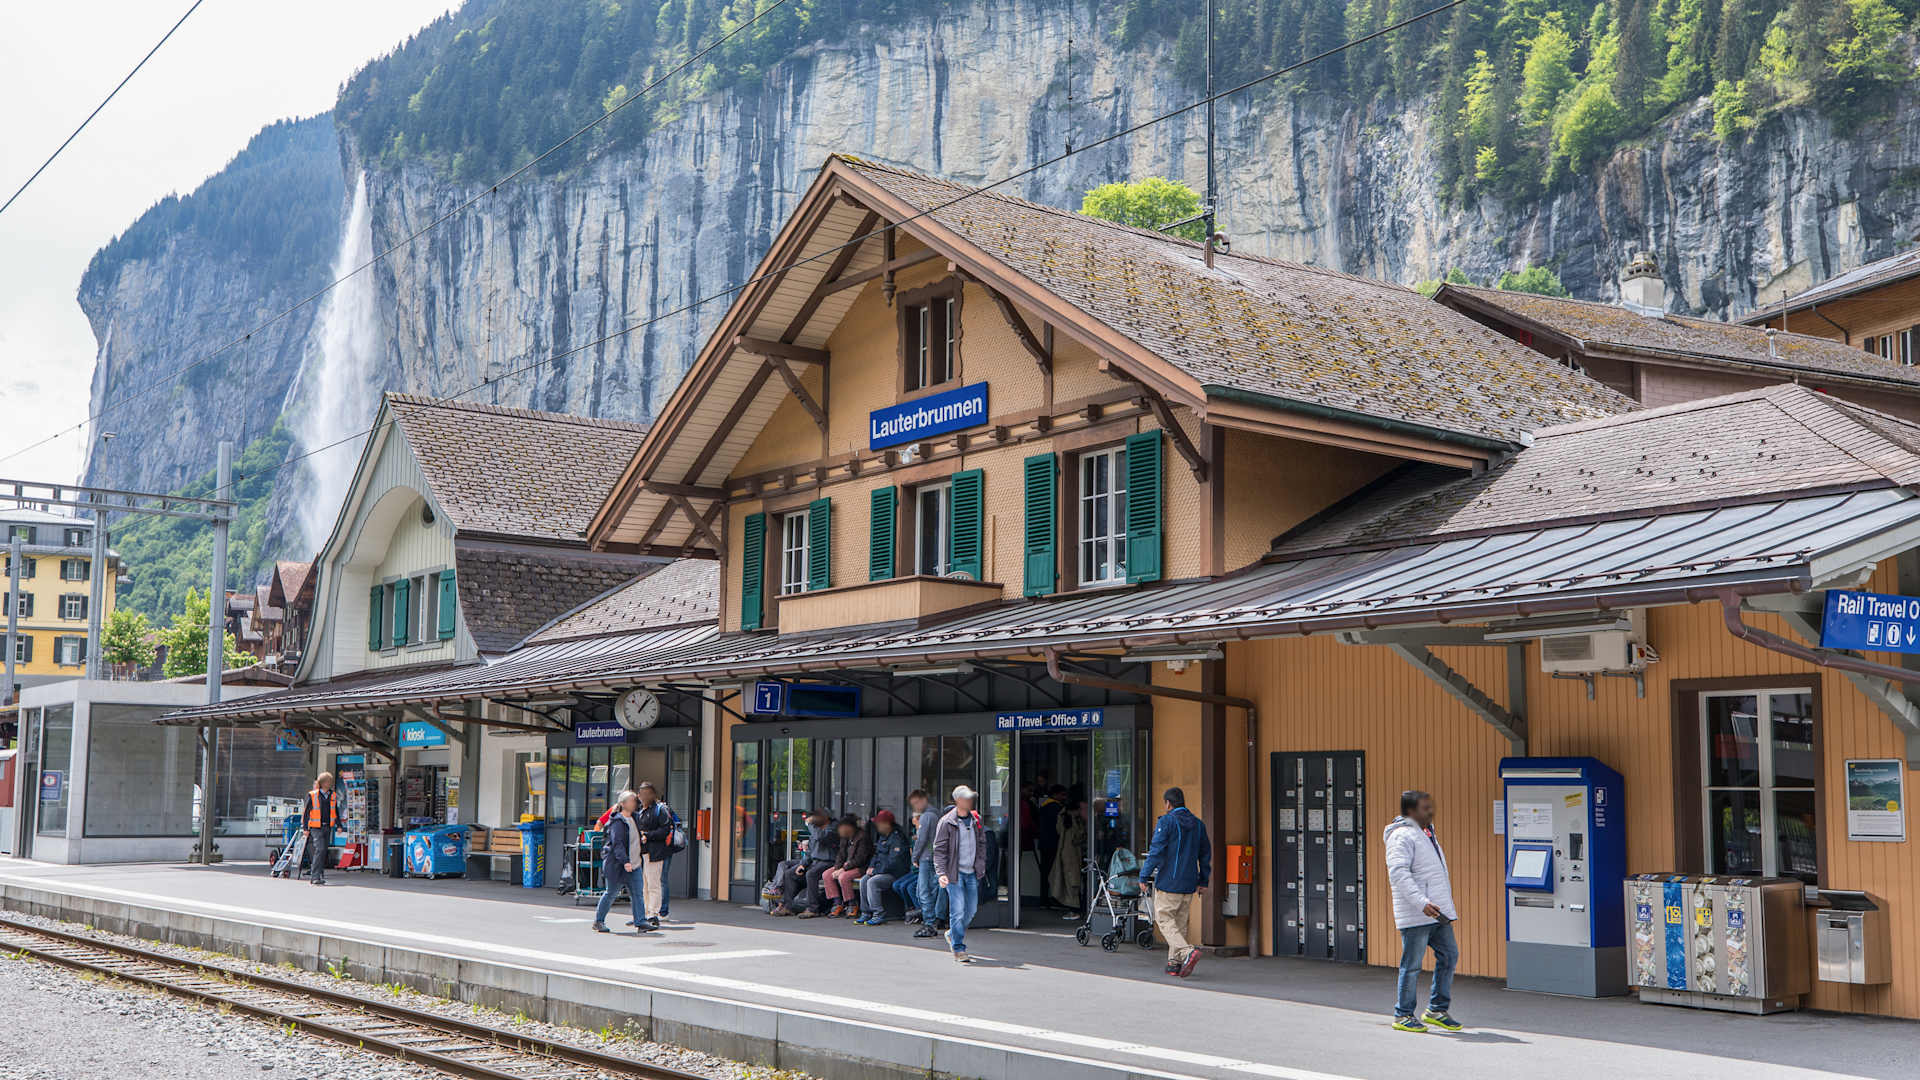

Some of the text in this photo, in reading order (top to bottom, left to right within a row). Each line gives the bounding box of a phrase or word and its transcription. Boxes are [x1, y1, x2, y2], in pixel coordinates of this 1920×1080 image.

[872, 396, 982, 440] Lauterbrunnen
[1838, 593, 1920, 620] Rail Travel O
[764, 692, 771, 708] 1
[998, 714, 1077, 728] Rail Travel Office
[407, 727, 425, 741] kiosk
[577, 726, 624, 738] Lauterbrunnen
